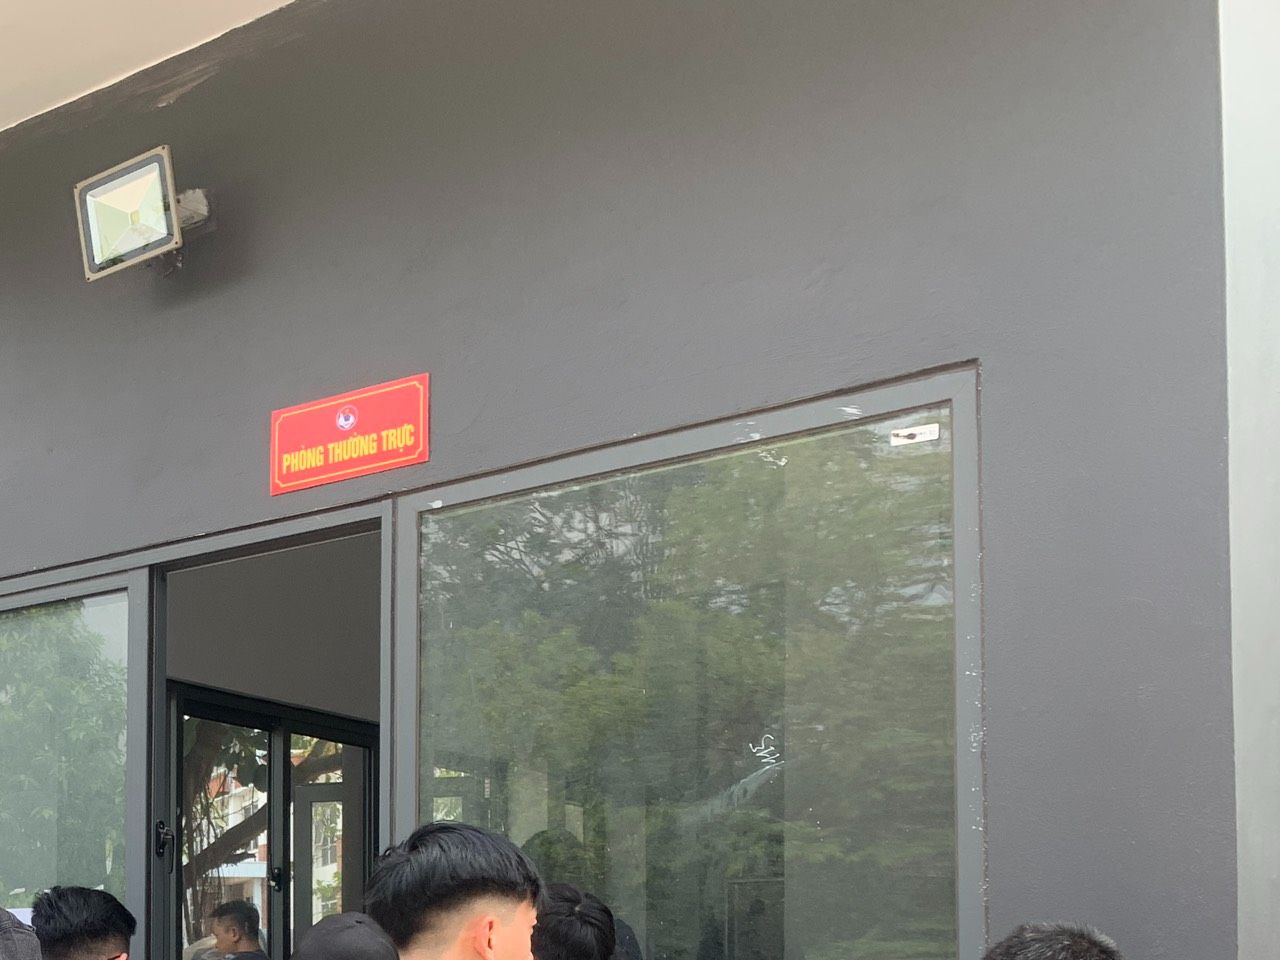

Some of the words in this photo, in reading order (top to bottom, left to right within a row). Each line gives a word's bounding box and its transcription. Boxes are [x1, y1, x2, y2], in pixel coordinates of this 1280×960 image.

[282, 444, 324, 474] PHÒNG
[328, 432, 378, 464] THƯỜNG
[381, 424, 415, 452] TRỰC
